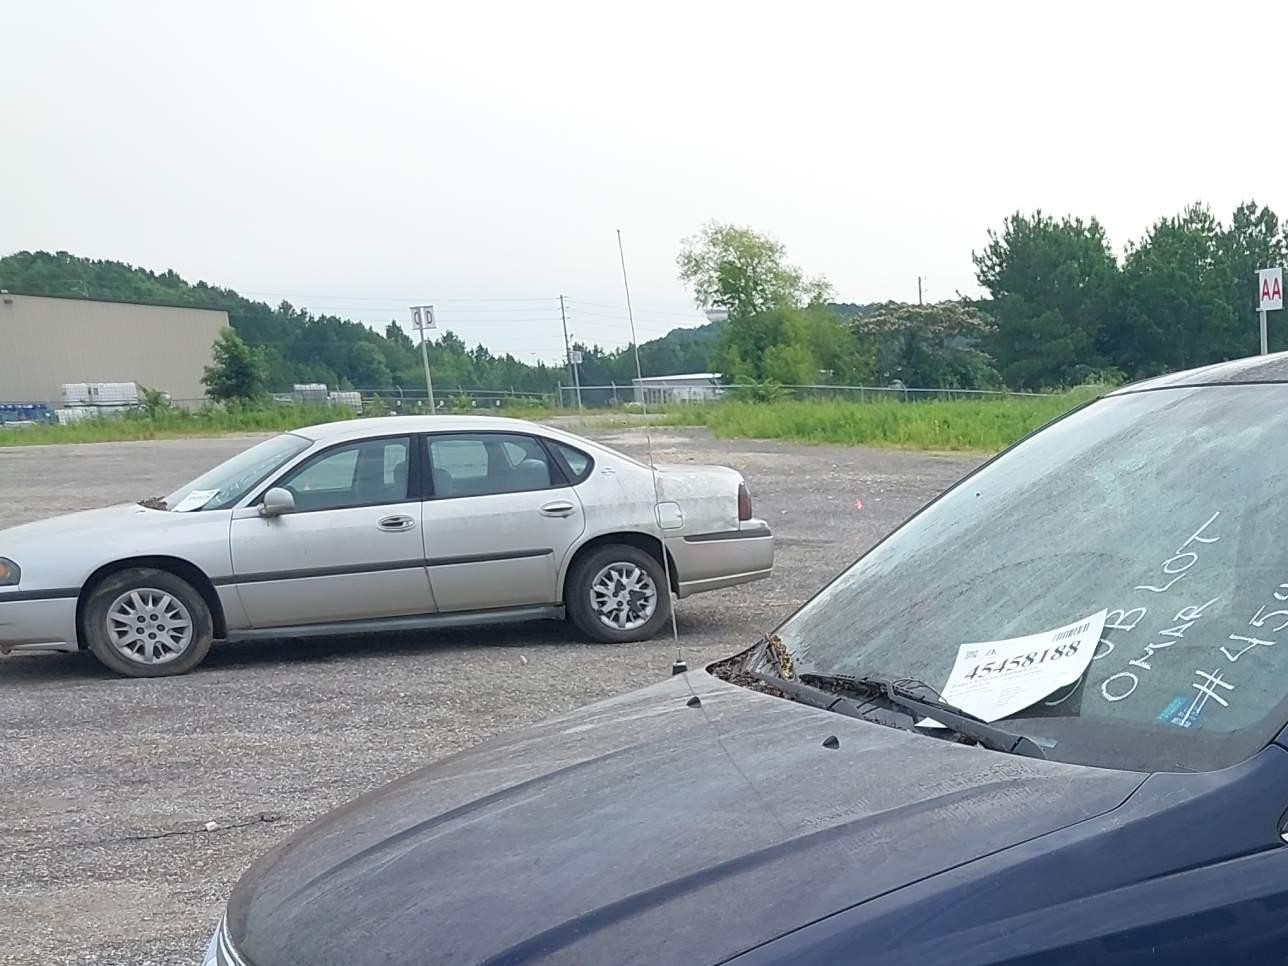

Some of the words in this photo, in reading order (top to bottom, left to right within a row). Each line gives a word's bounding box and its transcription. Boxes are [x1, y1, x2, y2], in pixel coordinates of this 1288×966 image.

[1261, 277, 1282, 302] AA
[1134, 511, 1220, 592] LOT
[964, 640, 1082, 680] 45458188
[1102, 597, 1221, 701] OMAR
